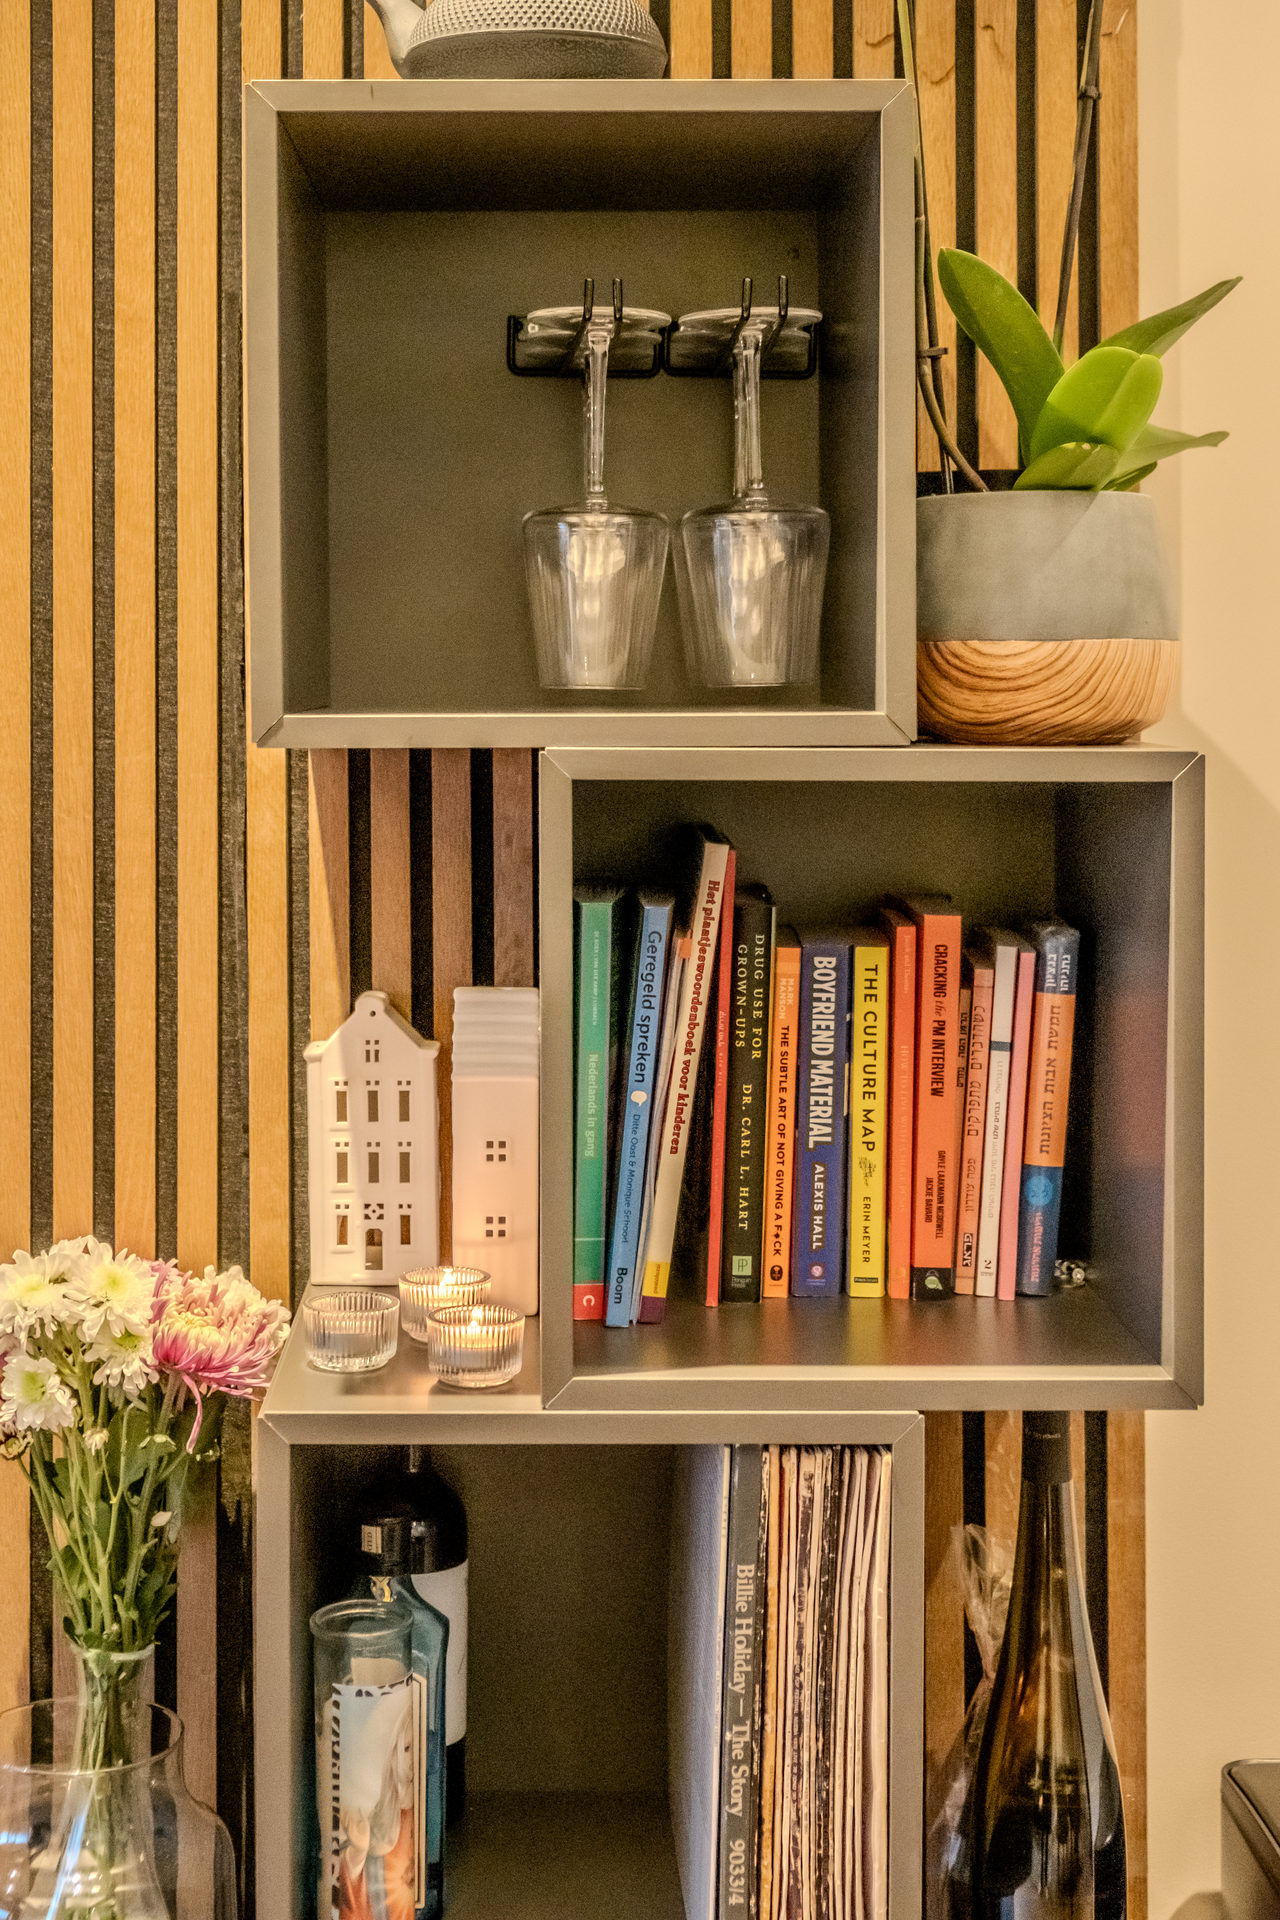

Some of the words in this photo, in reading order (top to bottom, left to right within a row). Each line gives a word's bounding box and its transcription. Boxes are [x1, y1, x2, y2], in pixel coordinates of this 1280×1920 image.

[706, 880, 720, 905] Het
[640, 930, 662, 1010] Geregeld
[754, 934, 765, 980] DRUG
[934, 944, 948, 998] CRACKING
[1045, 953, 1058, 987] בנציון
[1059, 954, 1071, 991] נתניהו
[684, 907, 714, 1056] plaatjeswoordenboek
[735, 944, 747, 1048] GROWN-UPS
[864, 964, 878, 1002] THE
[753, 989, 762, 1019] USE
[812, 956, 837, 1056] BOYFRIEND
[935, 1000, 946, 1017] the
[780, 1025, 790, 1047] THE
[933, 1020, 945, 1035] PM
[960, 1012, 968, 1035] הרמן
[972, 1005, 985, 1070] כשהדברים
[1048, 1005, 1060, 1051] חמשת
[634, 1015, 650, 1083] spreken
[751, 1027, 762, 1059] FOR
[863, 1010, 878, 1100] CULTURE
[958, 1038, 966, 1058] הסה
[587, 1054, 599, 1115] Nederlands
[678, 1058, 694, 1091] voor
[779, 1051, 788, 1093] SUBTLE
[931, 1039, 945, 1097] INTERVIEW
[1044, 1057, 1056, 1094] אבות
[742, 1083, 752, 1111] DR.
[778, 1097, 787, 1120] ART
[808, 1061, 834, 1148] MATERIAL
[967, 1081, 980, 1137] מתפרקים
[587, 1117, 598, 1128] in
[631, 1114, 640, 1135] Ditte
[670, 1094, 690, 1155] kinderen
[741, 1117, 751, 1158] CARL
[777, 1123, 786, 1139] OF
[861, 1109, 875, 1152] MAP
[1038, 1101, 1053, 1154] הציונות
[585, 1130, 596, 1158] gang
[629, 1137, 638, 1158] Oost
[776, 1142, 785, 1165] NOT
[937, 1150, 946, 1169] GAYLE
[624, 1169, 634, 1208] Monique
[740, 1166, 750, 1180] L.
[775, 1169, 784, 1209] GIVING
[813, 1164, 825, 1212] ALEXIS
[937, 1171, 945, 1204] LAAKMANN
[738, 1187, 749, 1231] HART
[774, 1213, 783, 1221] A
[862, 1197, 871, 1222] ERIN
[925, 1198, 933, 1223] BAVARO
[936, 1206, 944, 1239] MCDOWELL
[812, 1216, 822, 1250] HALL
[862, 1227, 871, 1264] MEYER
[963, 1234, 972, 1266] פראג
[614, 1267, 628, 1304] Boom
[735, 1564, 755, 1613] Billie
[728, 1617, 752, 1694] Holiday
[730, 1722, 751, 1759] The
[725, 1765, 749, 1817] Story
[728, 1839, 745, 1905] 9033/4
